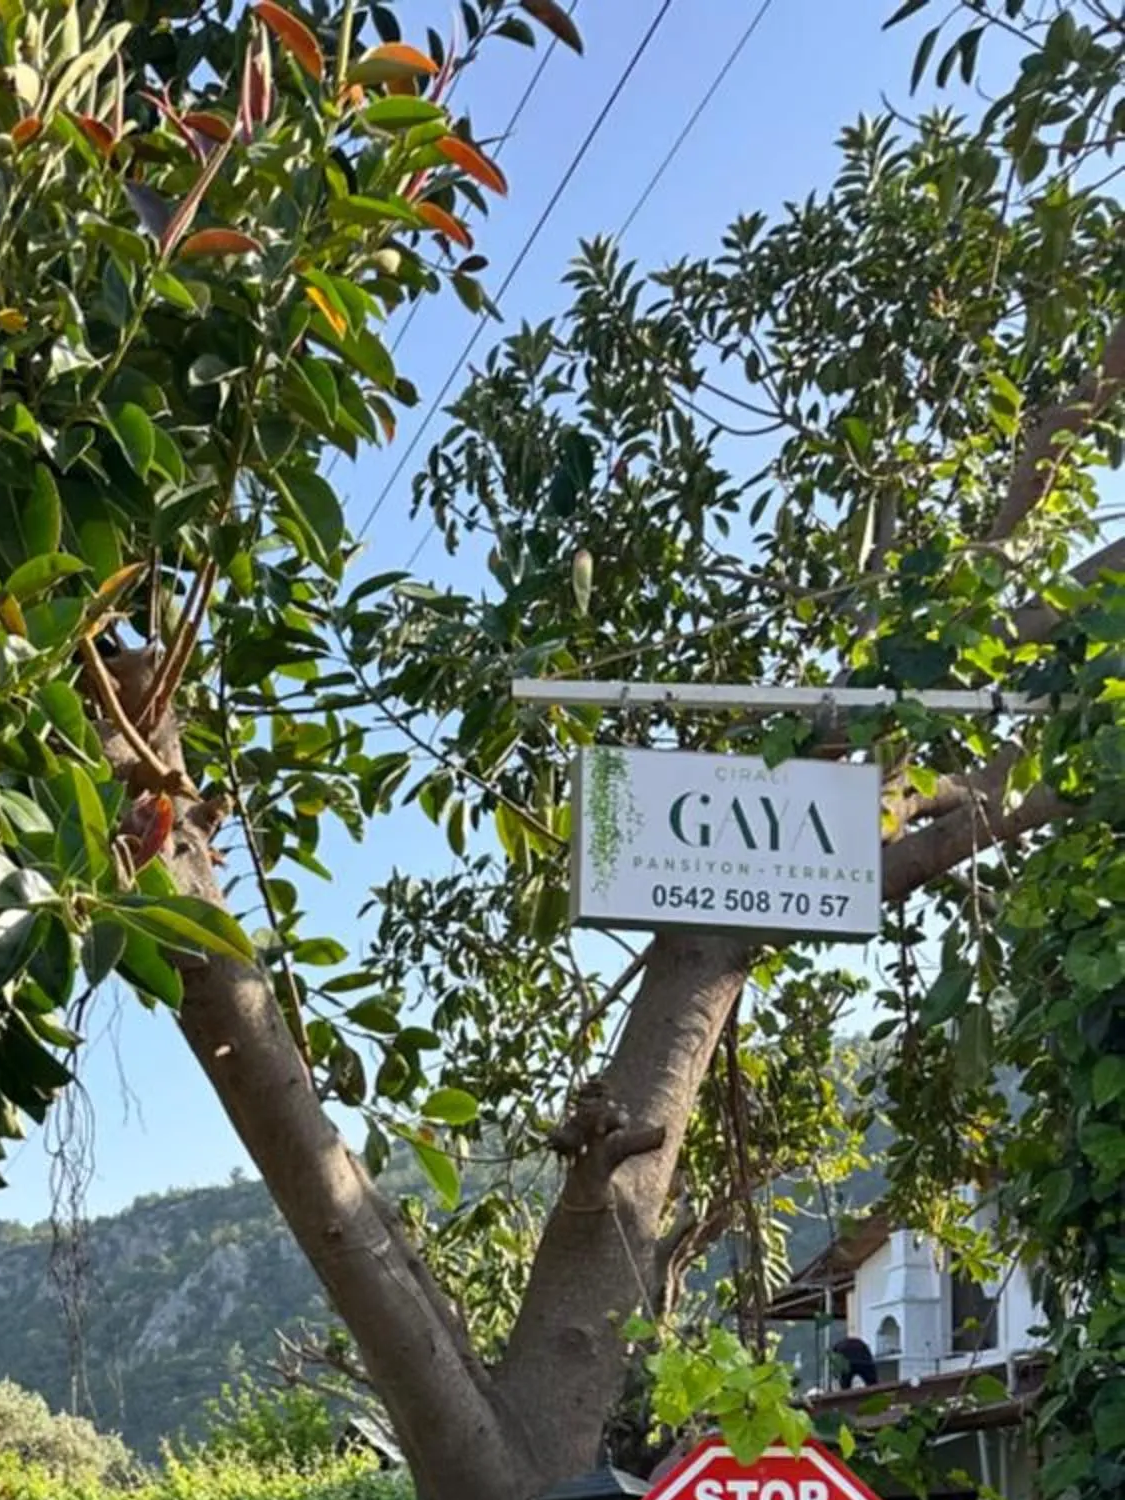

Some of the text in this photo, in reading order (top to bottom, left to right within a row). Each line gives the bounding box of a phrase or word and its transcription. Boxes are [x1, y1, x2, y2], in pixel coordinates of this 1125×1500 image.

[669, 790, 835, 855] GAYA
[774, 864, 875, 883] TERRACE
[651, 884, 851, 918] 0542 508 70 57
